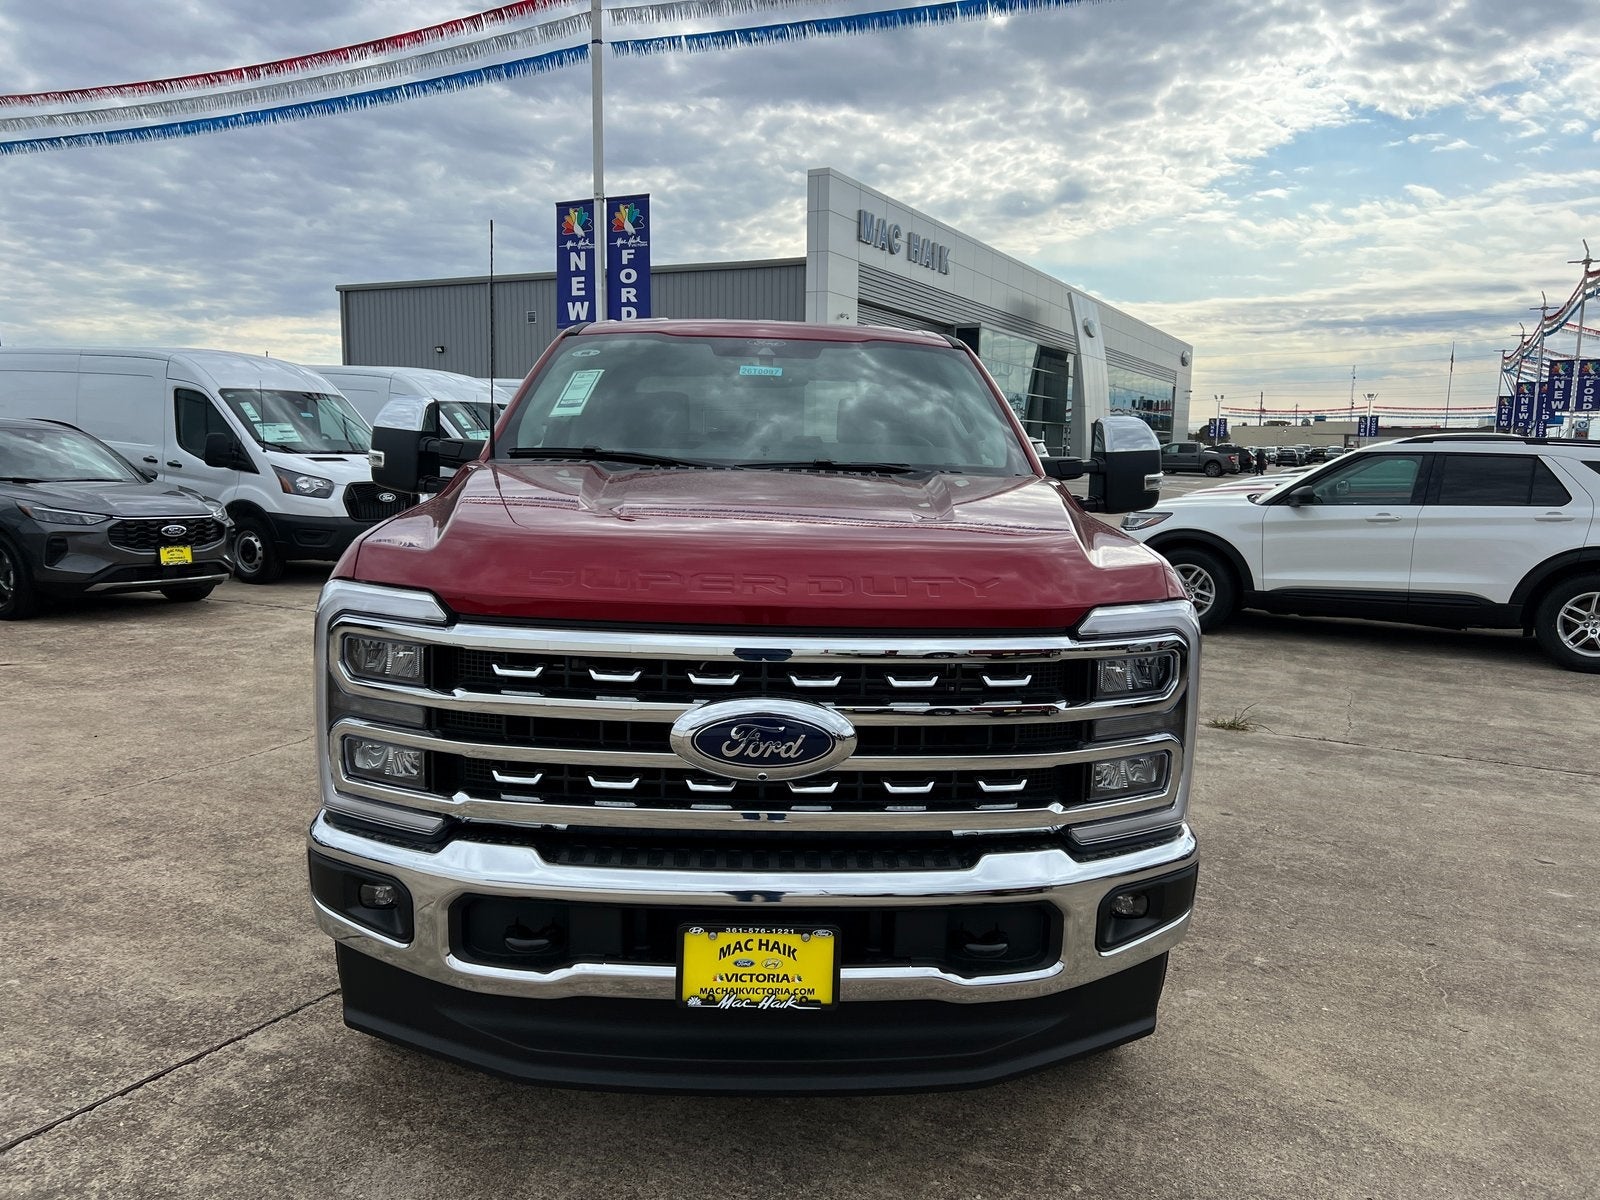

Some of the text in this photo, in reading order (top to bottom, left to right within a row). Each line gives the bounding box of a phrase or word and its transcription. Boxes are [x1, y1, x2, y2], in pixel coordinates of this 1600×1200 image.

[858, 209, 950, 275] MAC HAIK
[567, 251, 589, 320] NEW
[619, 249, 638, 320] FORD
[1551, 380, 1565, 409] NEW
[1582, 380, 1594, 410] FORD
[1500, 408, 1508, 426] NEW
[1518, 397, 1529, 420] NEW
[527, 567, 1000, 598] SUPER DUTY
[721, 723, 804, 759] Ford
[725, 927, 795, 935] 361-576-1221
[718, 938, 798, 962] MAC HAIK
[724, 973, 791, 983] VICTORIA
[699, 987, 815, 996] MACHAIKVICTORIA.COM
[718, 993, 798, 1010] Mac Haik
